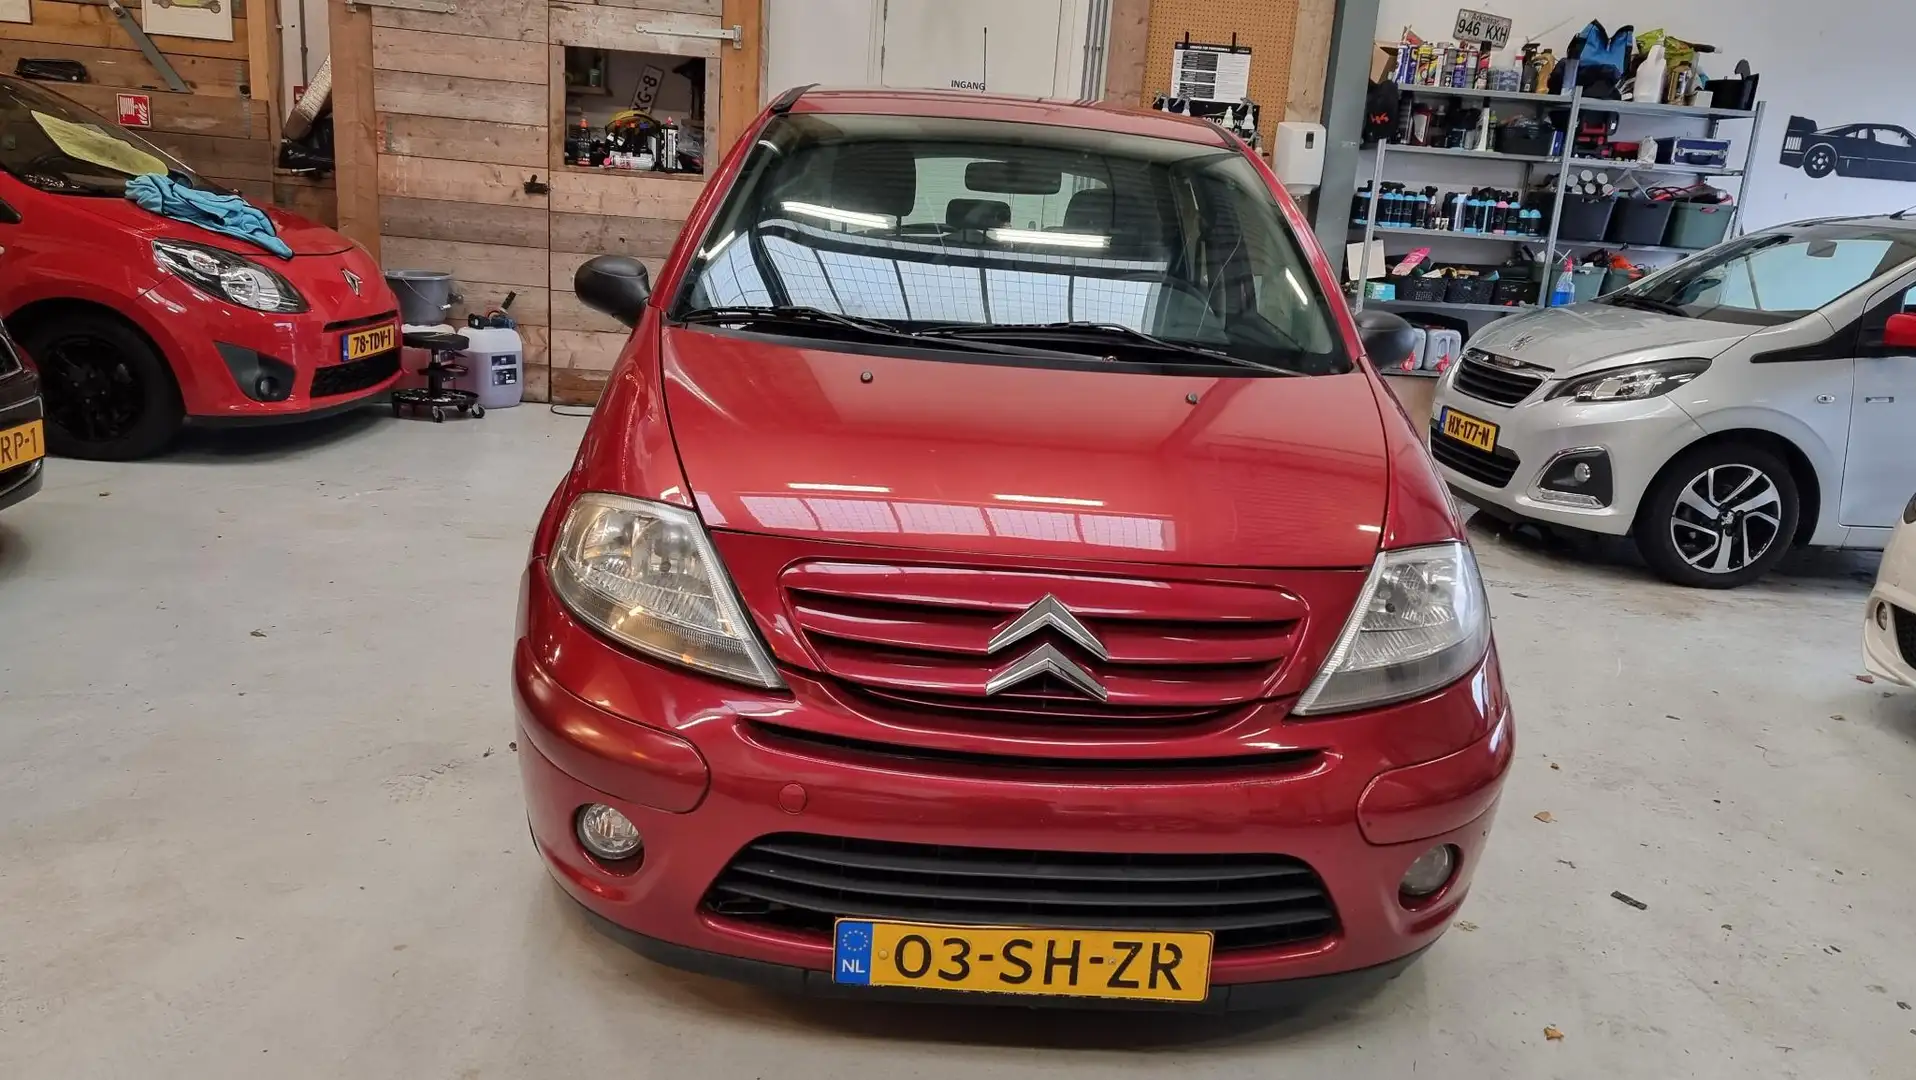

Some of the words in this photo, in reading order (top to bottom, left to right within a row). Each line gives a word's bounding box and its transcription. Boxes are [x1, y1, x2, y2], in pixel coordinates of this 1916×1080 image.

[1457, 19, 1481, 36] 946
[1485, 24, 1508, 43] KXH
[951, 80, 986, 91] INGANG
[353, 329, 391, 355] 78-TDV-1
[1448, 415, 1490, 446] HX-177-N
[0, 427, 37, 464] RP-1
[841, 959, 865, 974] NL
[894, 934, 1183, 991] 03-SH-ZR
